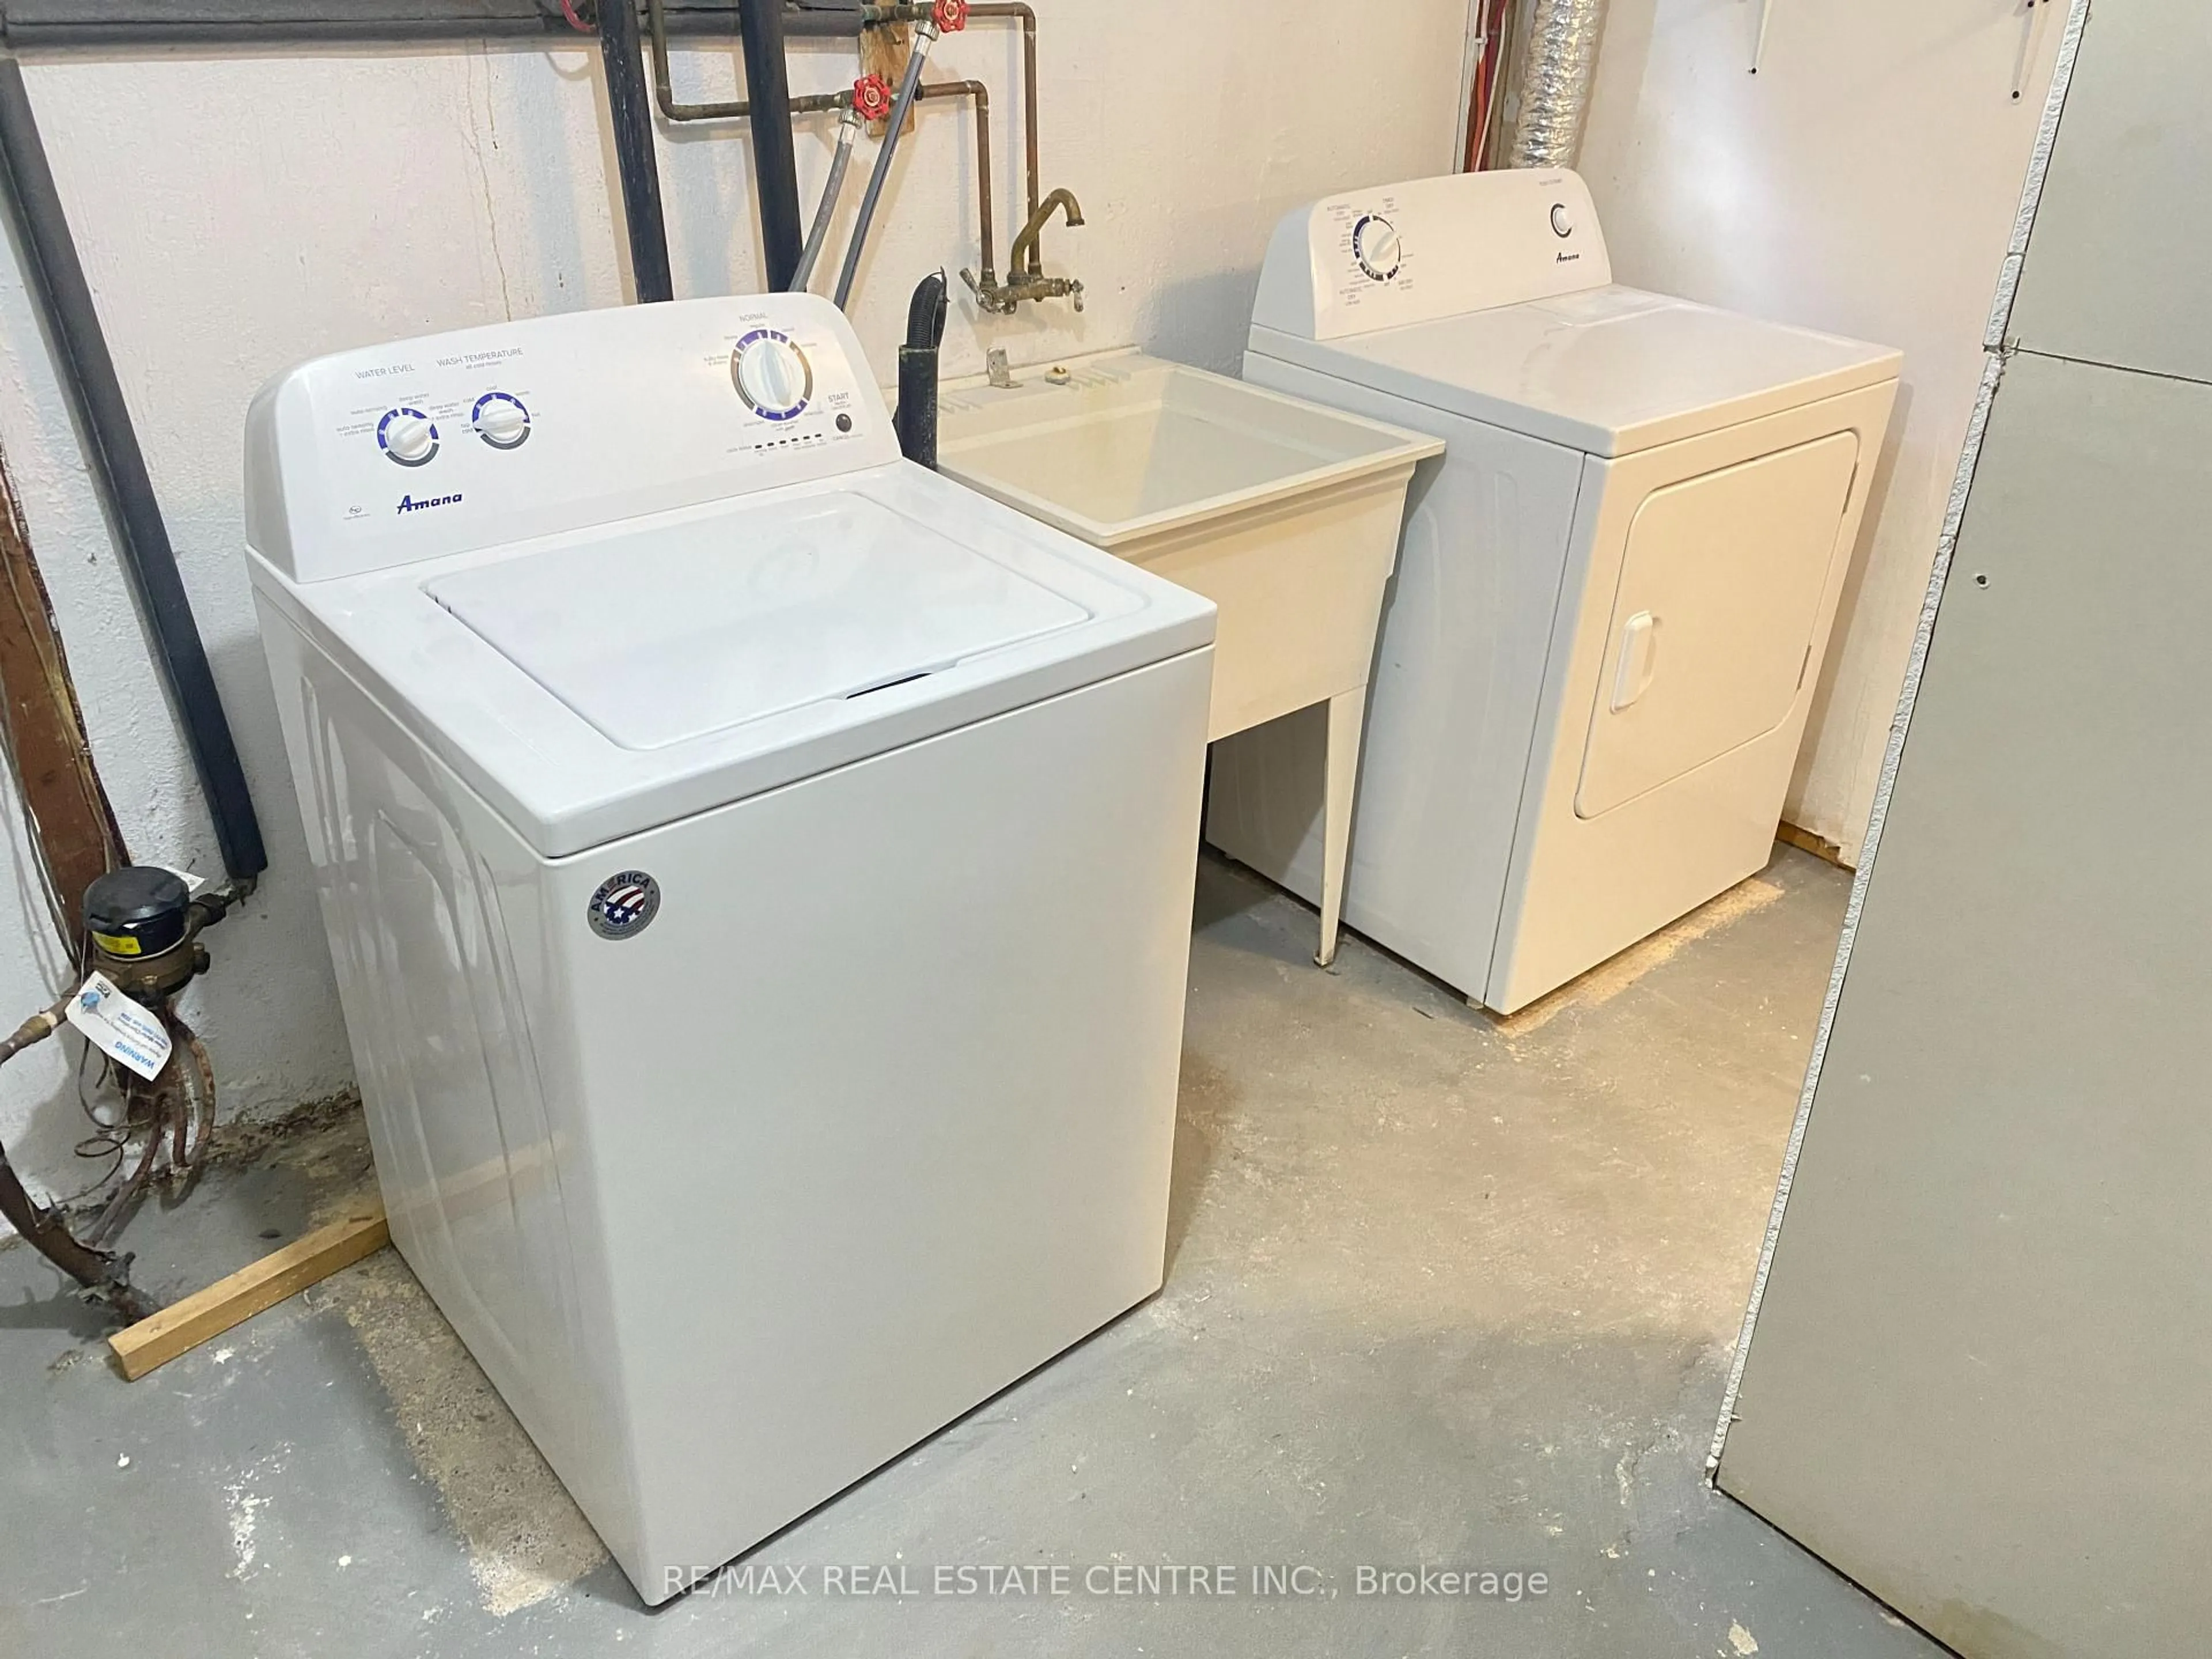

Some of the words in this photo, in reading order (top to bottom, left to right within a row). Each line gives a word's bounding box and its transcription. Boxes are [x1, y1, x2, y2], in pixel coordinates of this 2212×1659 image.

[1556, 252, 1580, 264] Amana
[739, 313, 768, 322] NORMAL
[436, 356, 463, 367] WASH
[464, 347, 524, 363] TEMPERATURE
[354, 367, 387, 379] WATER
[388, 363, 415, 374] LEVEL
[828, 392, 849, 403] START
[396, 493, 463, 514] Amana
[591, 873, 650, 912] AMERICA
[115, 1041, 155, 1070] WARNING
